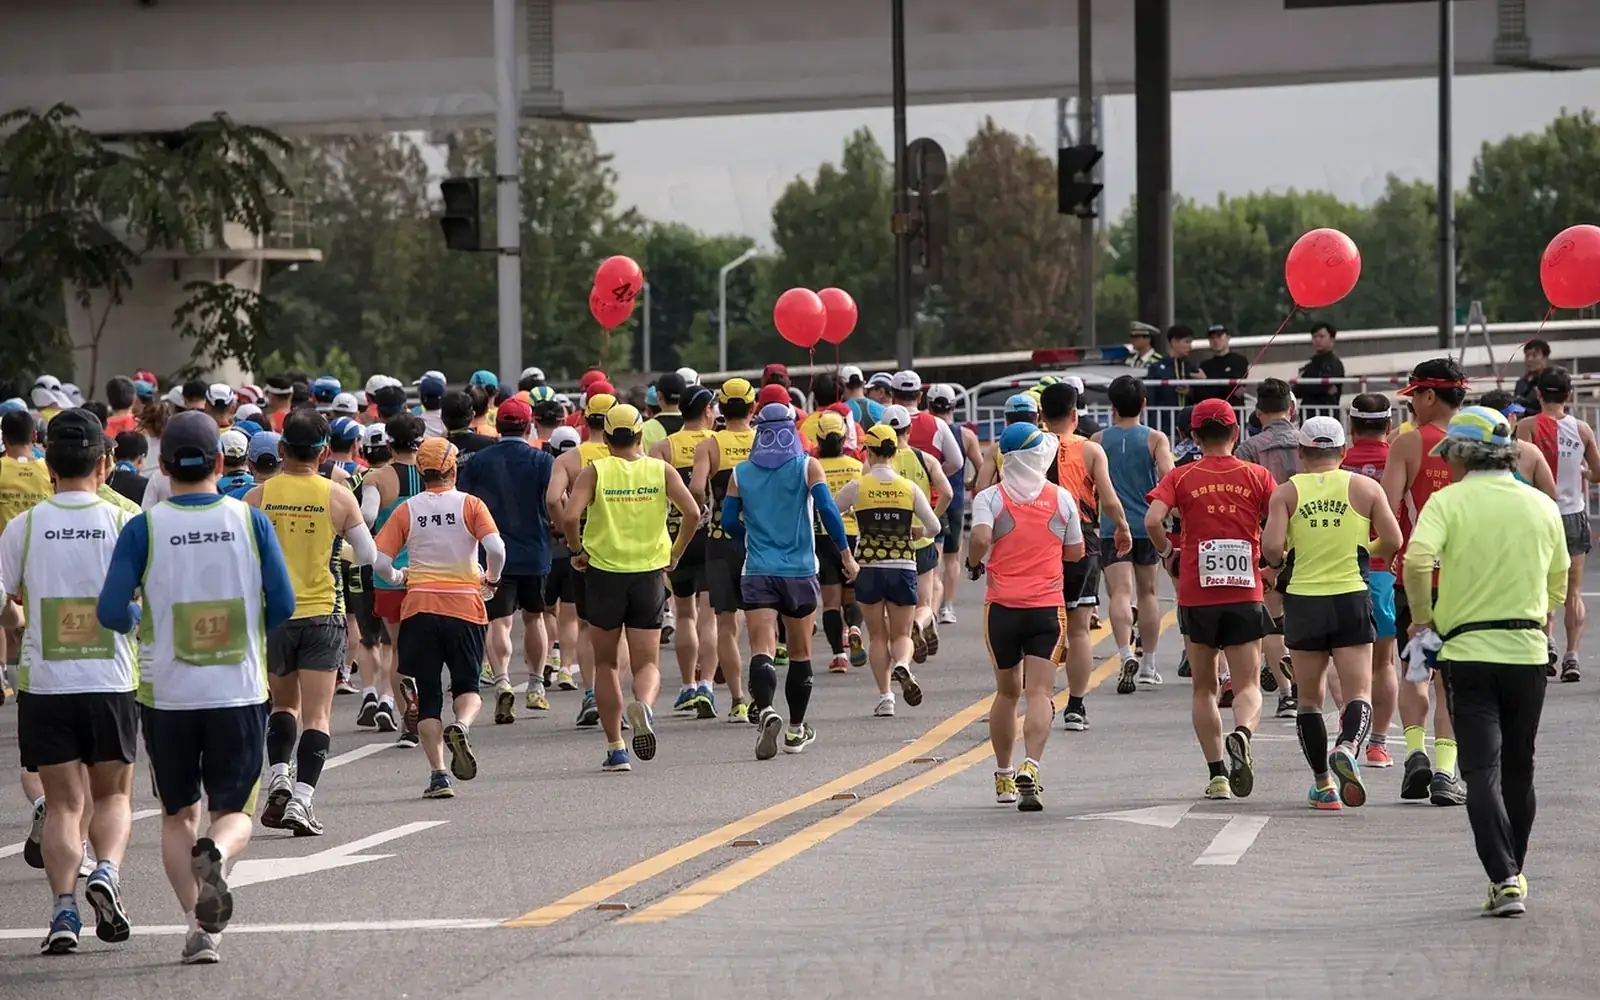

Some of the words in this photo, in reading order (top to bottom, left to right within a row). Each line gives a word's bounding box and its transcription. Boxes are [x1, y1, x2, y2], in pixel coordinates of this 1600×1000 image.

[637, 486, 659, 495] Club
[265, 504, 302, 512] Runners
[304, 505, 325, 513] Club
[45, 528, 106, 540] 이브자리
[170, 531, 235, 546] 이브자리
[1205, 554, 1248, 572] 5:00
[1206, 576, 1226, 586] Pace
[1226, 576, 1250, 586] Maker
